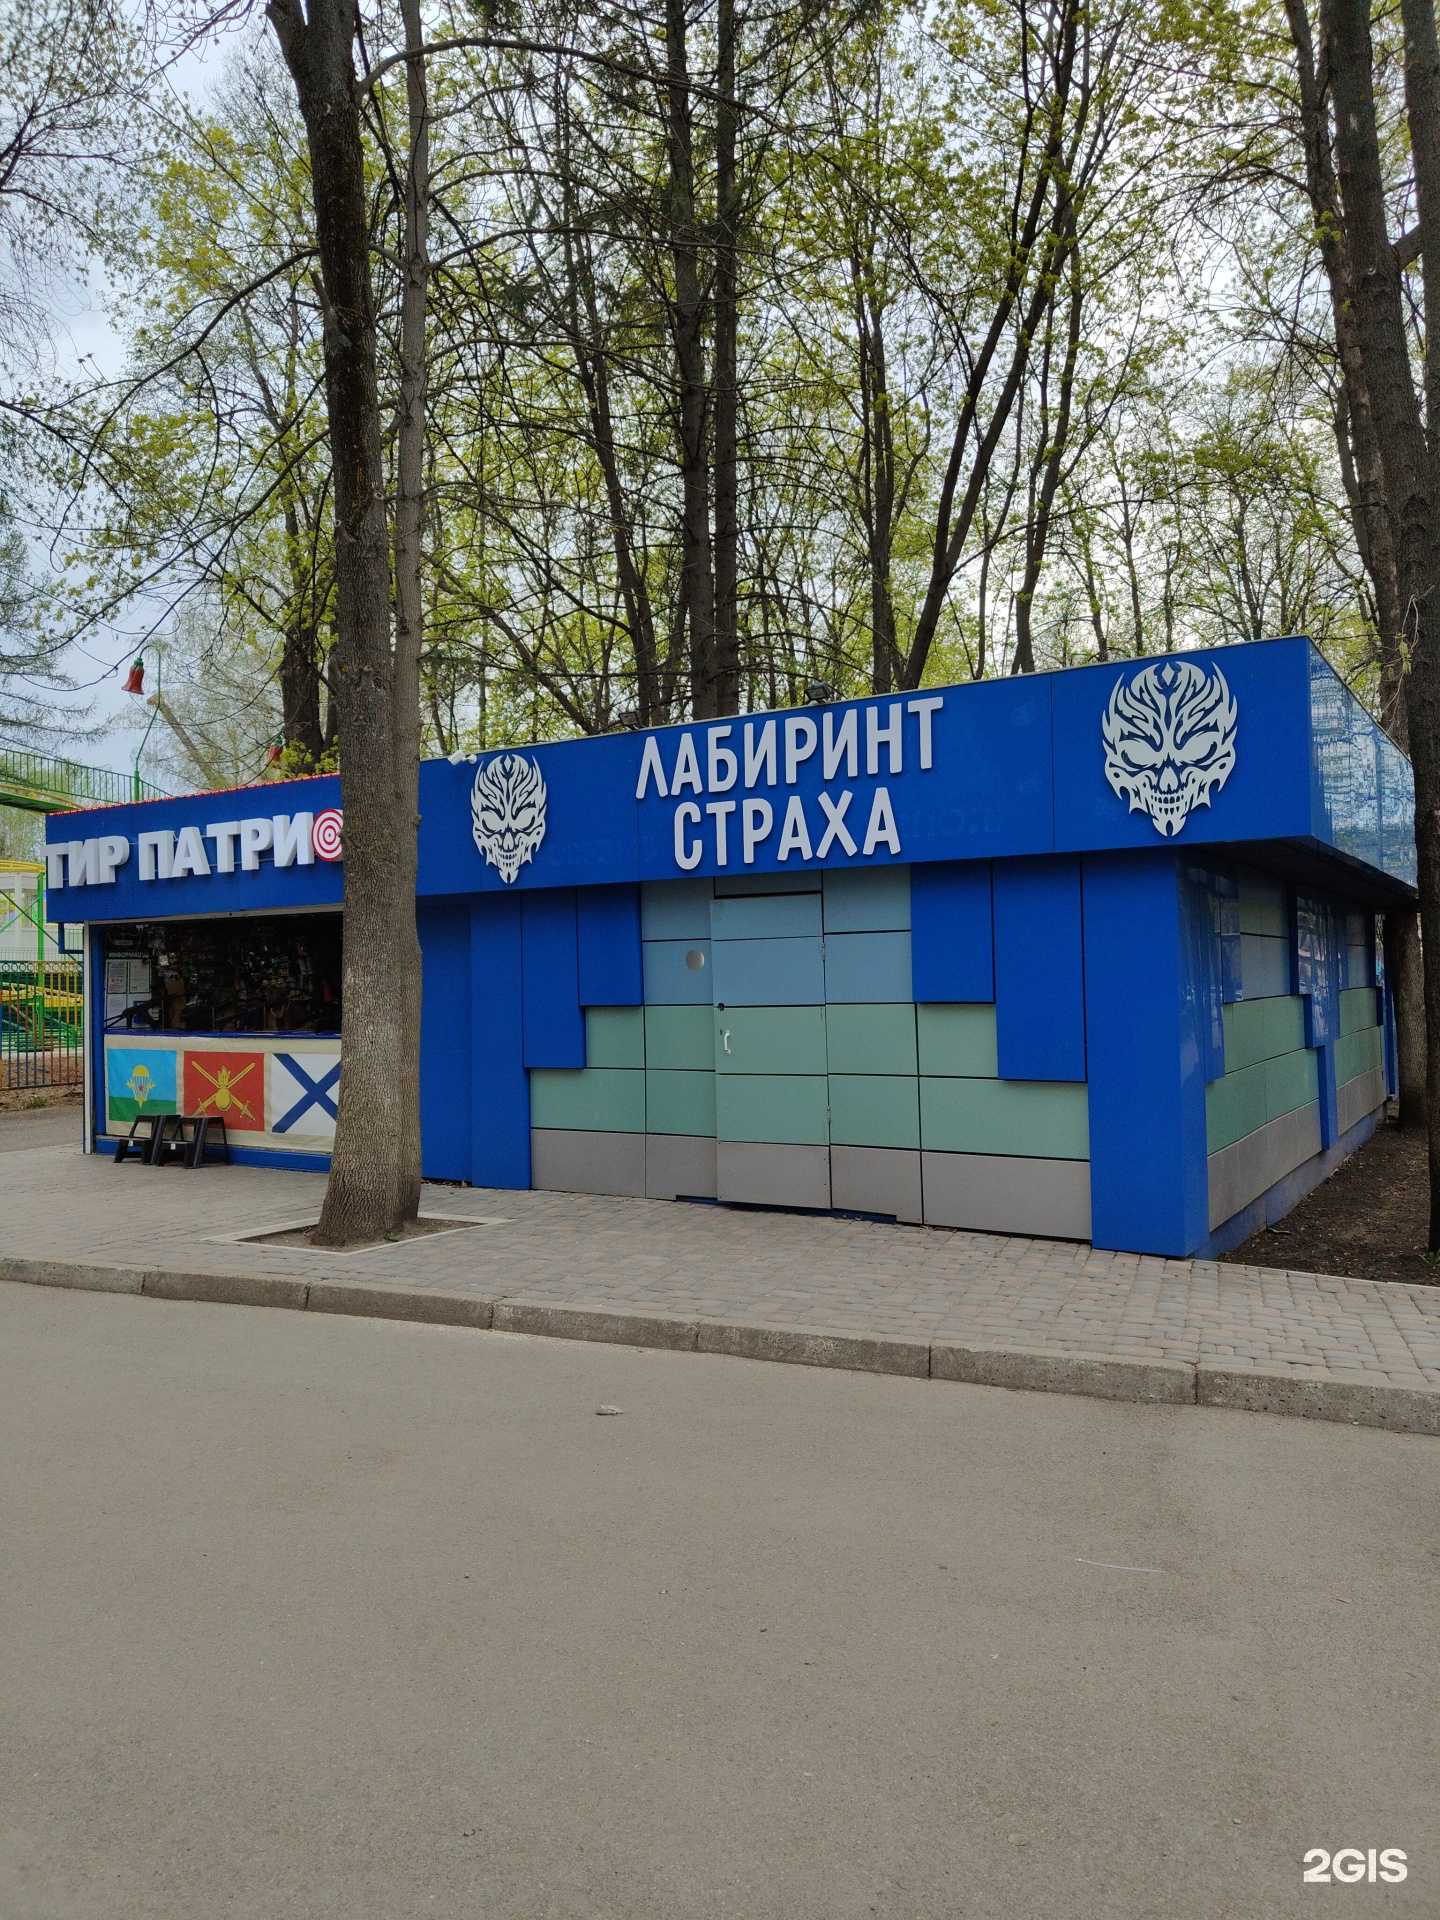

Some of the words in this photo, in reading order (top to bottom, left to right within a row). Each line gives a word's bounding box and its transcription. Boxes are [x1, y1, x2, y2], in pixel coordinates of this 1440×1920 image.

[636, 697, 943, 799] ЛАБИРИНТ
[41, 835, 130, 889] ТИР
[674, 787, 901, 870] СТРАХА
